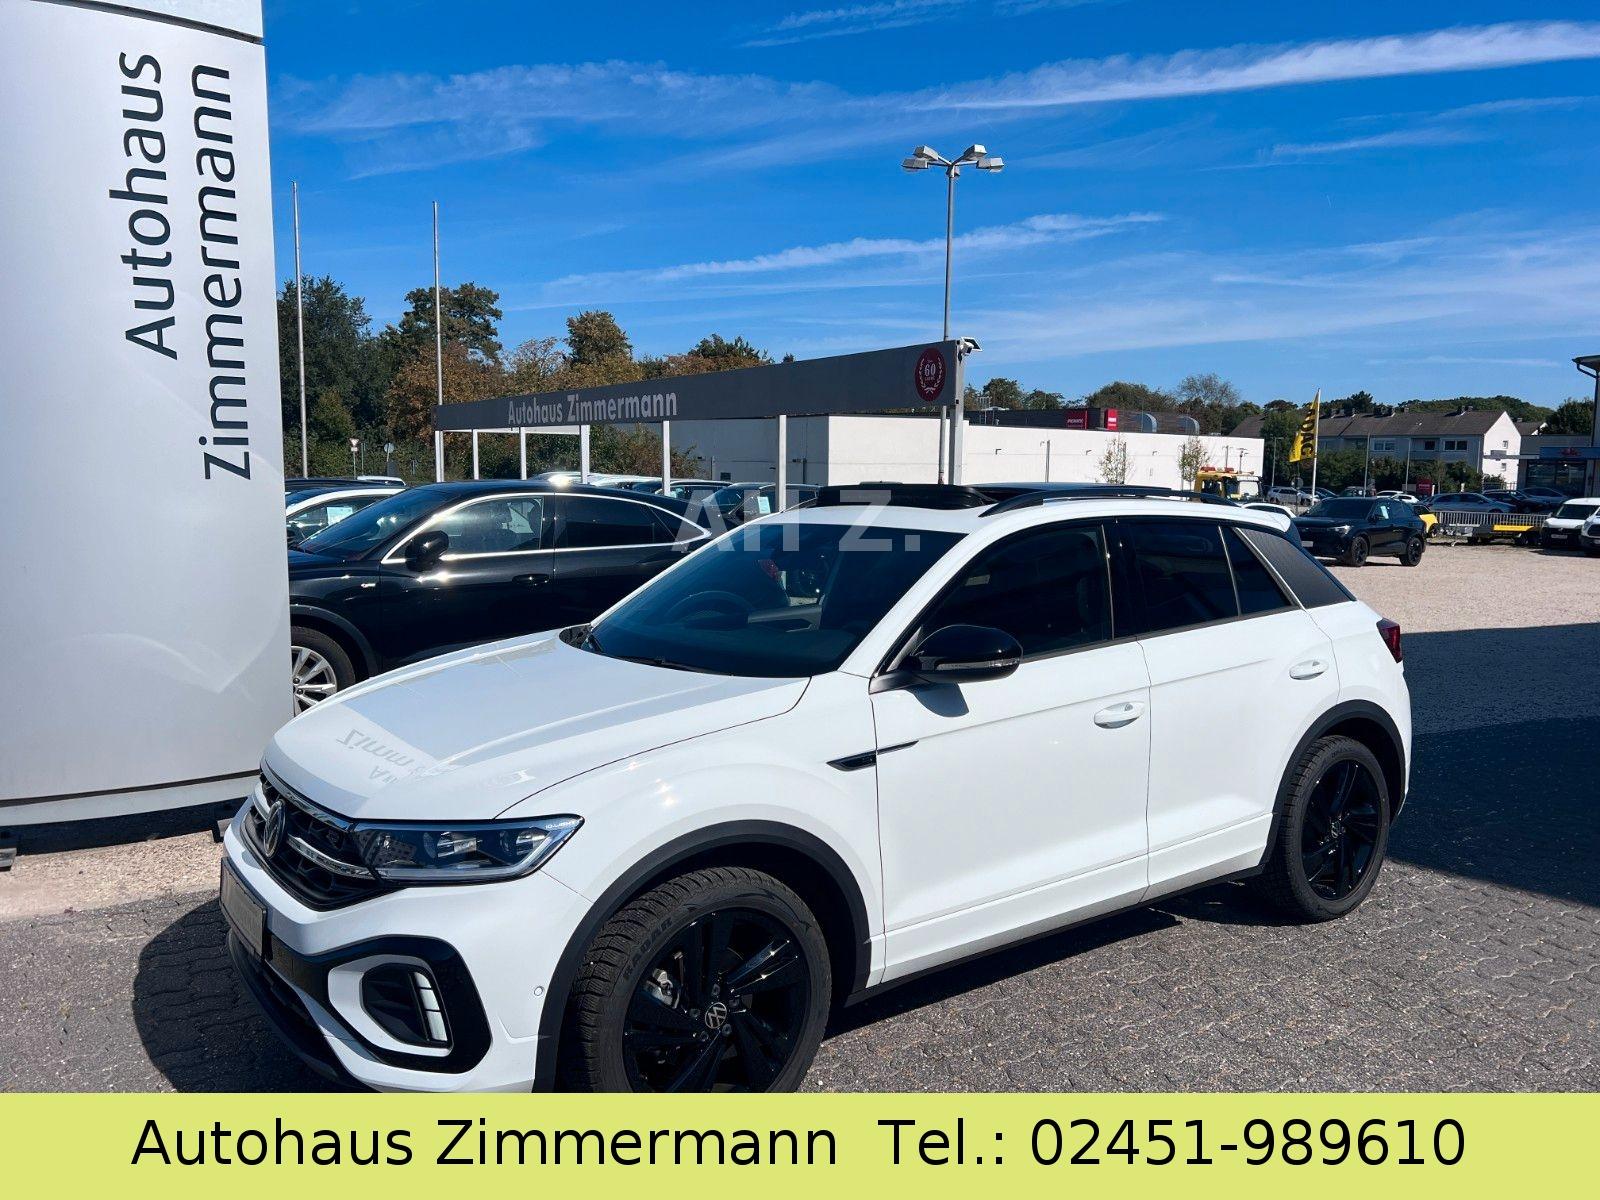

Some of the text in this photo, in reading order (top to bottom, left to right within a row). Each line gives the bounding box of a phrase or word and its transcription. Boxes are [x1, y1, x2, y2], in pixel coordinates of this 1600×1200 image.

[108, 51, 178, 361] Autohaus
[191, 64, 251, 481] Zimmermann
[508, 391, 678, 425] Autohaus Zimmermann
[924, 363, 936, 377] 60
